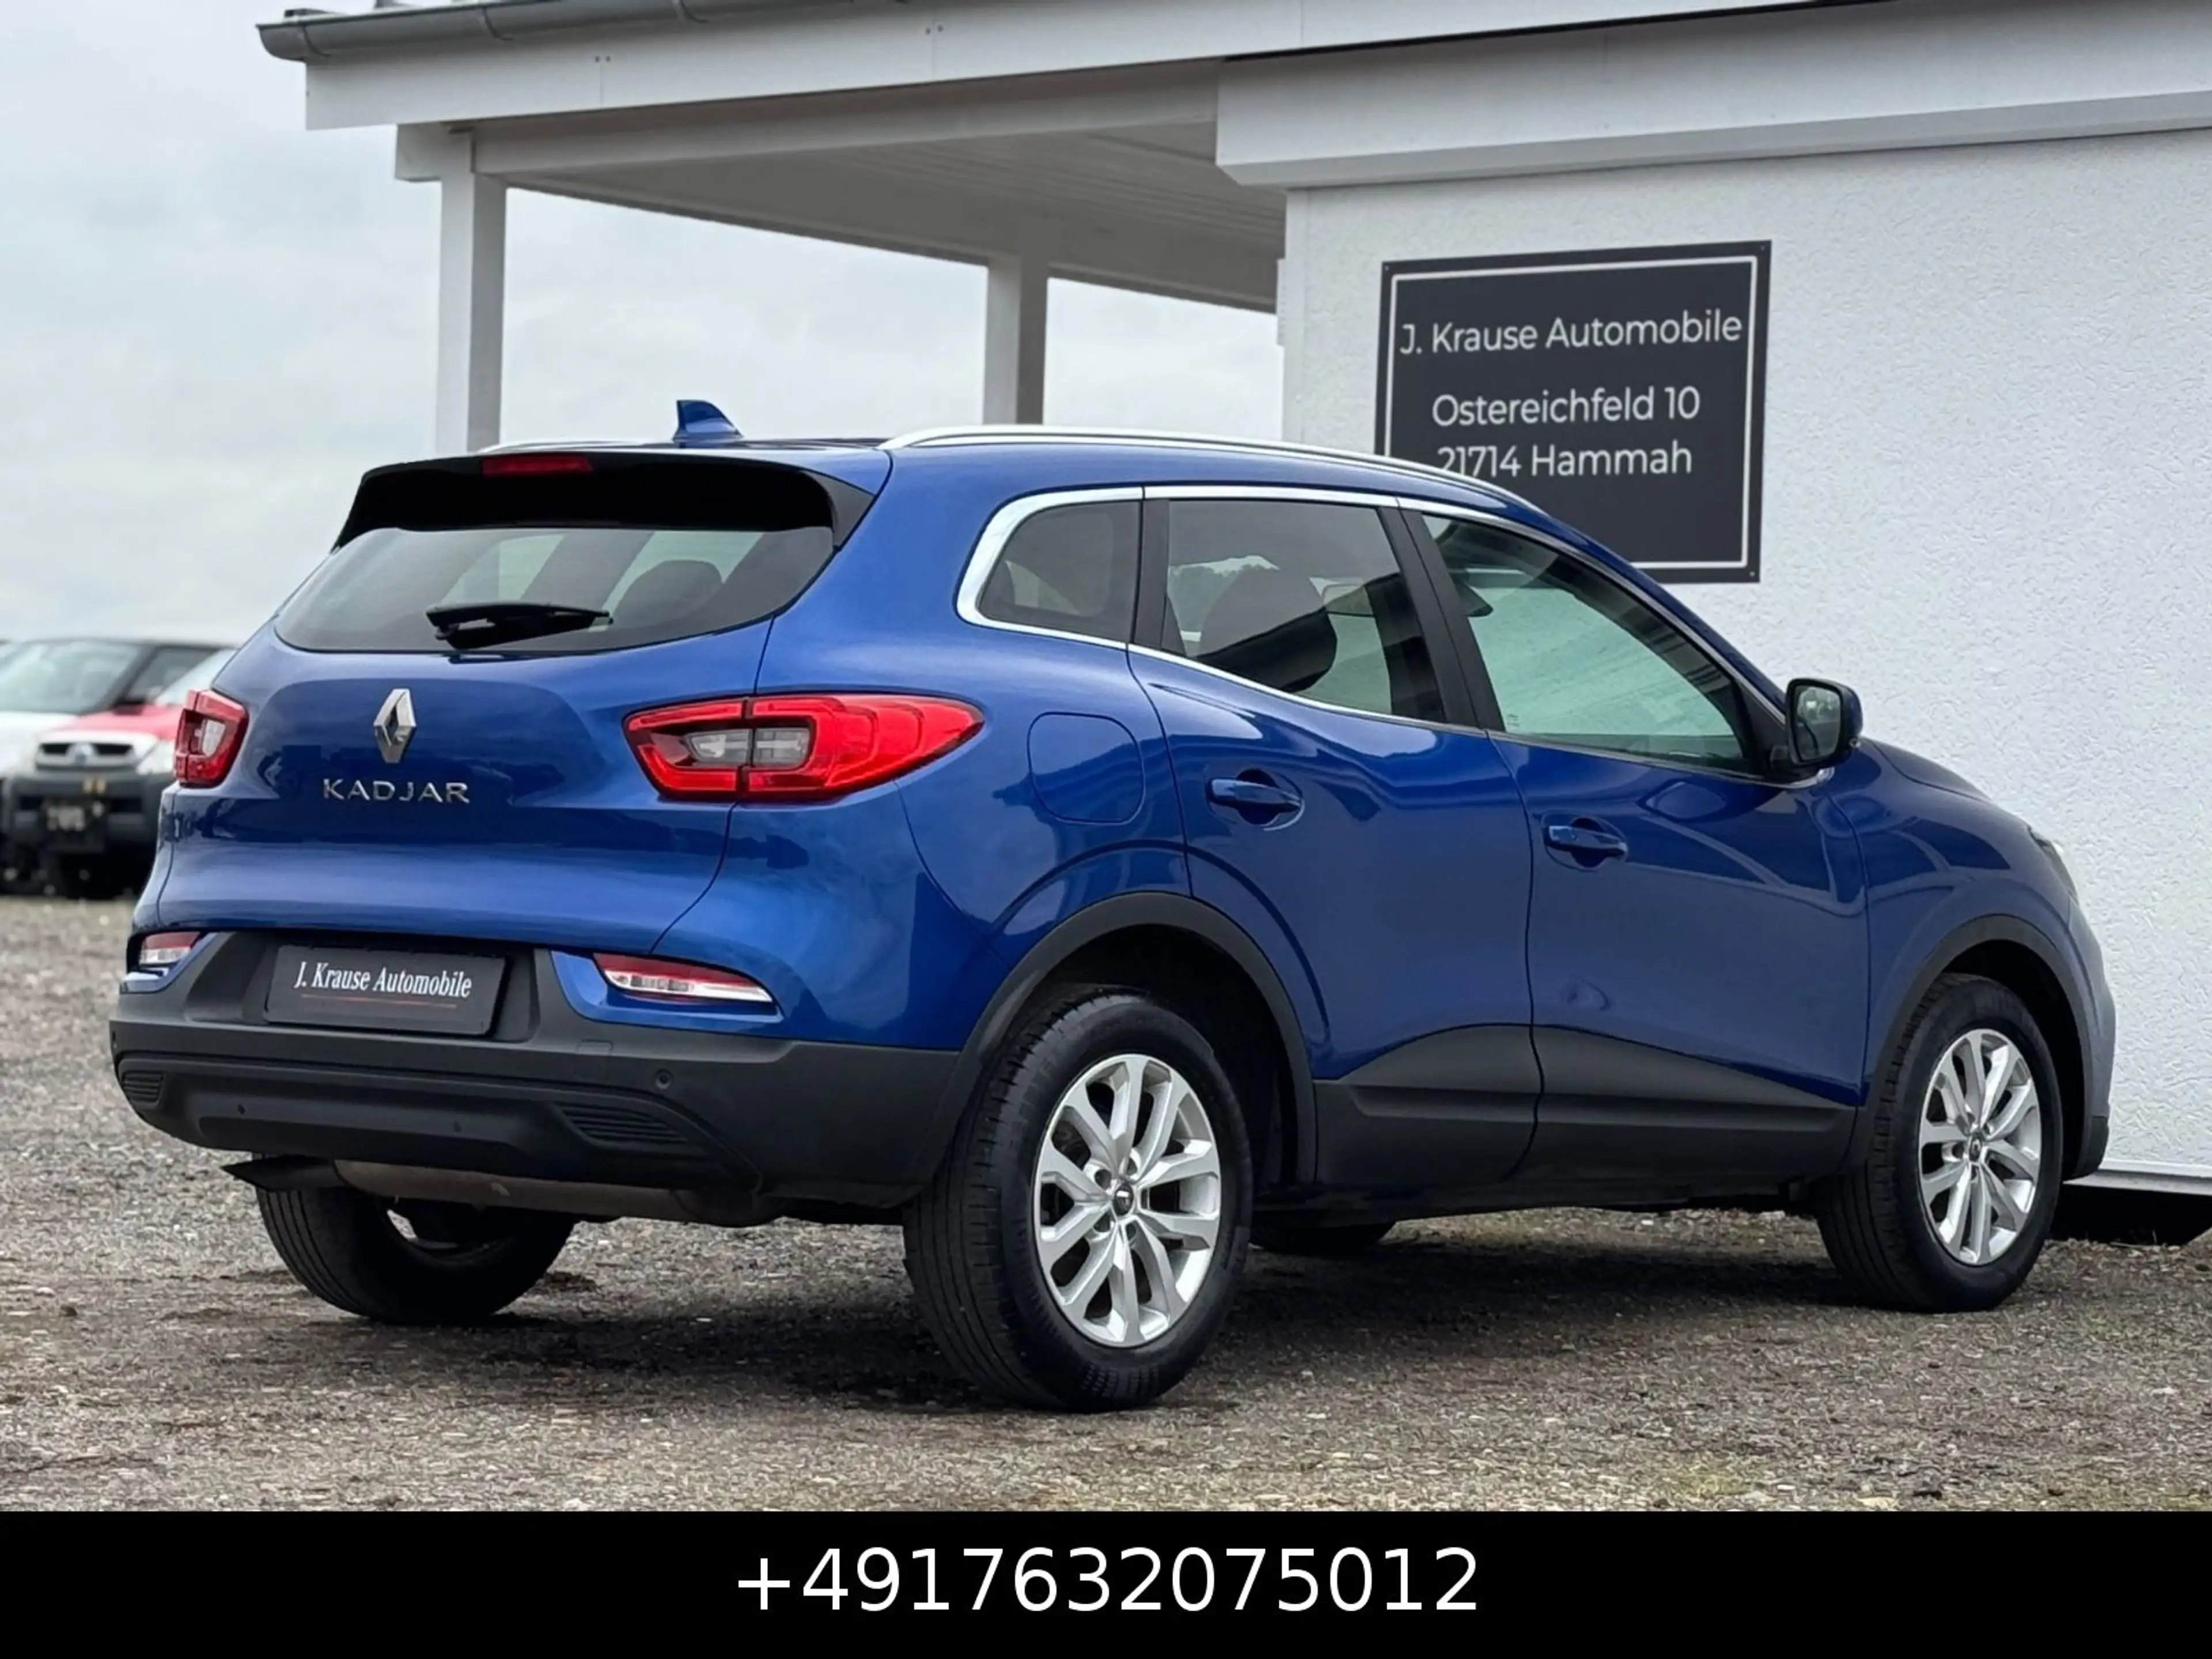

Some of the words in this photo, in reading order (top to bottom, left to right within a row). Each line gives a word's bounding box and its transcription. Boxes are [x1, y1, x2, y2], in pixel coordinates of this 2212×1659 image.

[1400, 324, 1422, 355] J.
[1432, 322, 1538, 353] Krause
[1546, 309, 1743, 349] Automobile
[1432, 385, 1654, 427] Ostereichfeld
[1664, 385, 1700, 419] 10
[1437, 444, 1521, 477] 21714
[1531, 440, 1692, 476] Hammah
[323, 778, 470, 804] KADJAR
[294, 961, 308, 988] J.
[312, 963, 370, 991] Krause
[373, 967, 472, 998] Automobile
